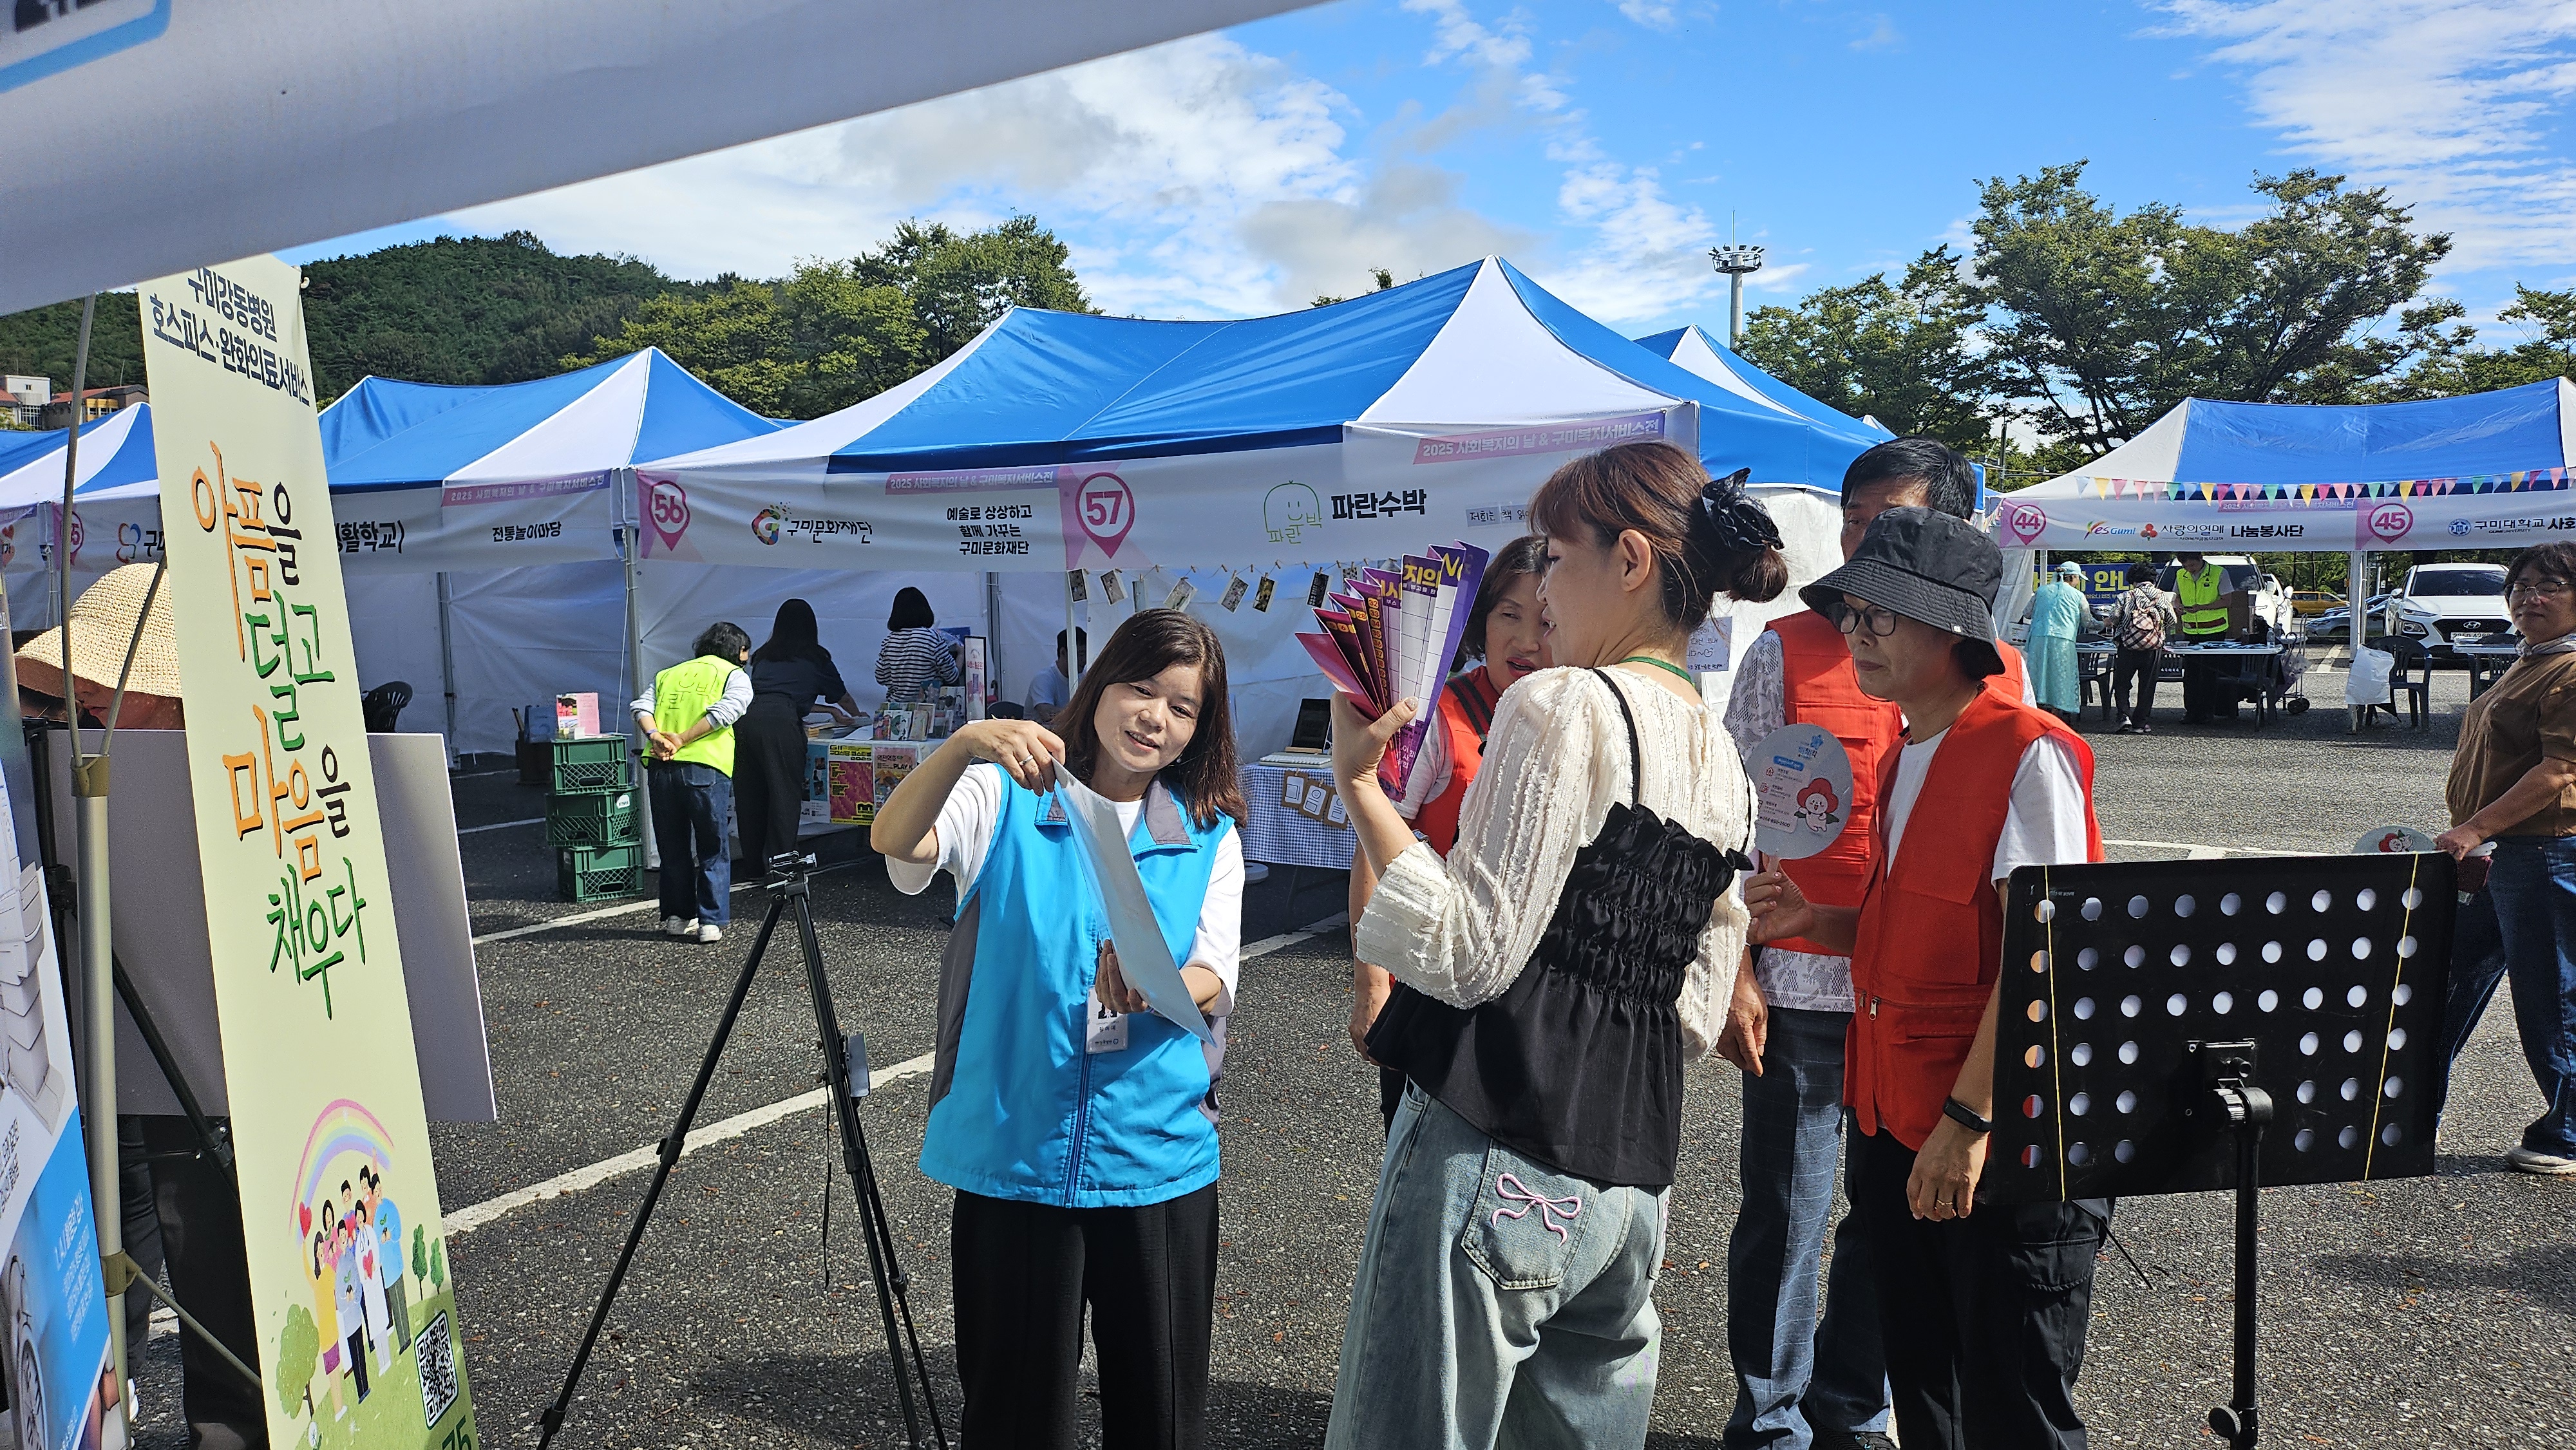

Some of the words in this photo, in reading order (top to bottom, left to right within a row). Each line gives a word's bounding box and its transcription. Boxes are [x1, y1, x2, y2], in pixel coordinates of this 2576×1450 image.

[187, 267, 278, 343] 구미강동병원
[1423, 442, 1454, 458] 2025
[1455, 436, 1519, 455] 사회복지의
[1522, 435, 1537, 448] 날
[1538, 433, 1549, 445] &
[1551, 419, 1660, 445] 구미복지서비스전
[891, 478, 913, 491] 2025
[913, 476, 958, 490] 사회복지의
[960, 475, 969, 487] 날
[451, 491, 473, 502] 2025
[1331, 489, 1427, 520] 파란수박
[654, 494, 685, 524] 56
[946, 506, 981, 522] 예술로
[984, 504, 1033, 520] 상상하고
[1085, 490, 1124, 527] 57
[1469, 510, 1496, 522] 저희는
[1501, 509, 1512, 521] 책
[958, 524, 984, 538] 함께
[987, 523, 1022, 538] 가꾸는
[2014, 513, 2041, 530] 44
[2161, 524, 2224, 536] 사랑의열매
[2374, 512, 2405, 531] 45
[2474, 517, 2546, 530] 구미대학교
[491, 521, 563, 543] 전통놀이마당
[786, 519, 874, 544] 구미문화재단
[2110, 527, 2137, 535] Gumi
[2231, 524, 2305, 538] 나눔봉사단
[191, 440, 303, 663] 아픔을
[958, 541, 1030, 556] 구미문화재단
[1368, 599, 1378, 608] 32
[245, 589, 336, 751] 덜고
[222, 704, 351, 885] 마음을
[266, 856, 366, 1021] 채우다
